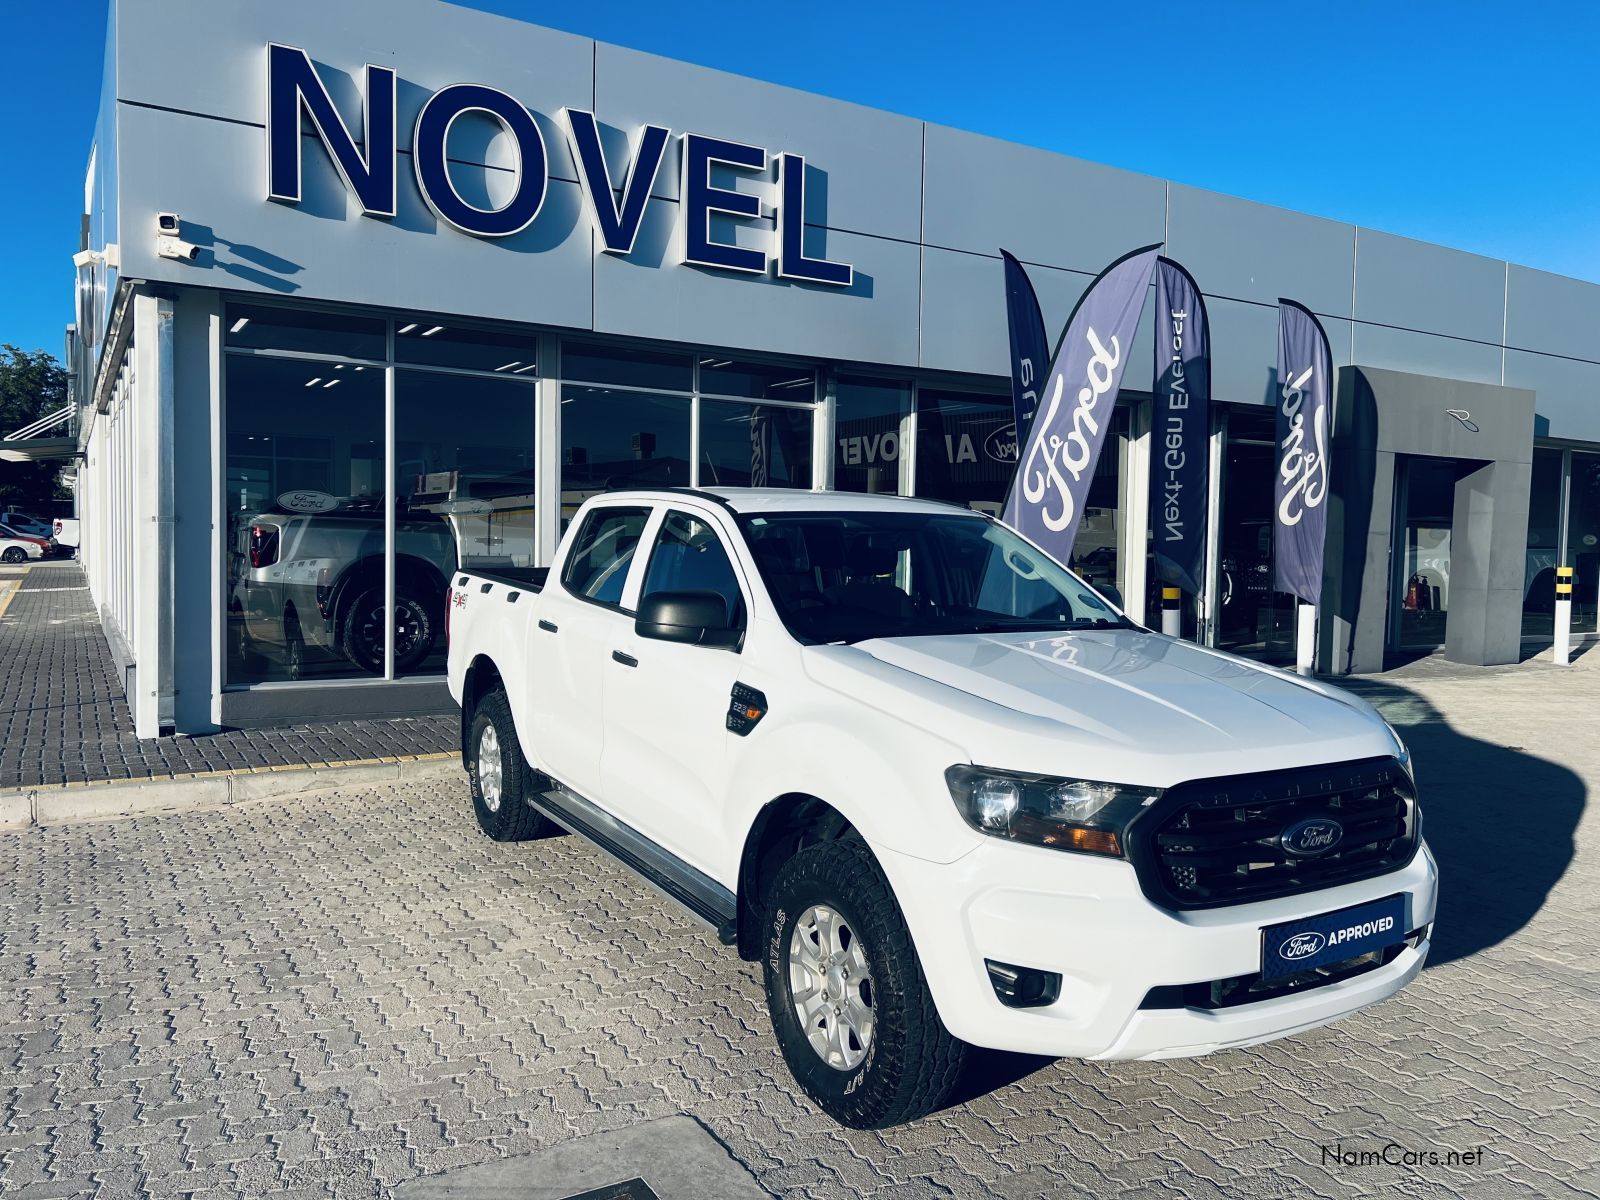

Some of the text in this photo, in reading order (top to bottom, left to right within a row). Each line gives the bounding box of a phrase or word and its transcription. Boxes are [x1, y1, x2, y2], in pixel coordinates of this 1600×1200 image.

[266, 41, 853, 287] NOVEL
[1023, 326, 1120, 532] Ford
[290, 493, 326, 510] Ford
[1300, 825, 1334, 848] Ford
[769, 909, 788, 974] ATLAS
[1287, 916, 1394, 957] Ford APPROVED
